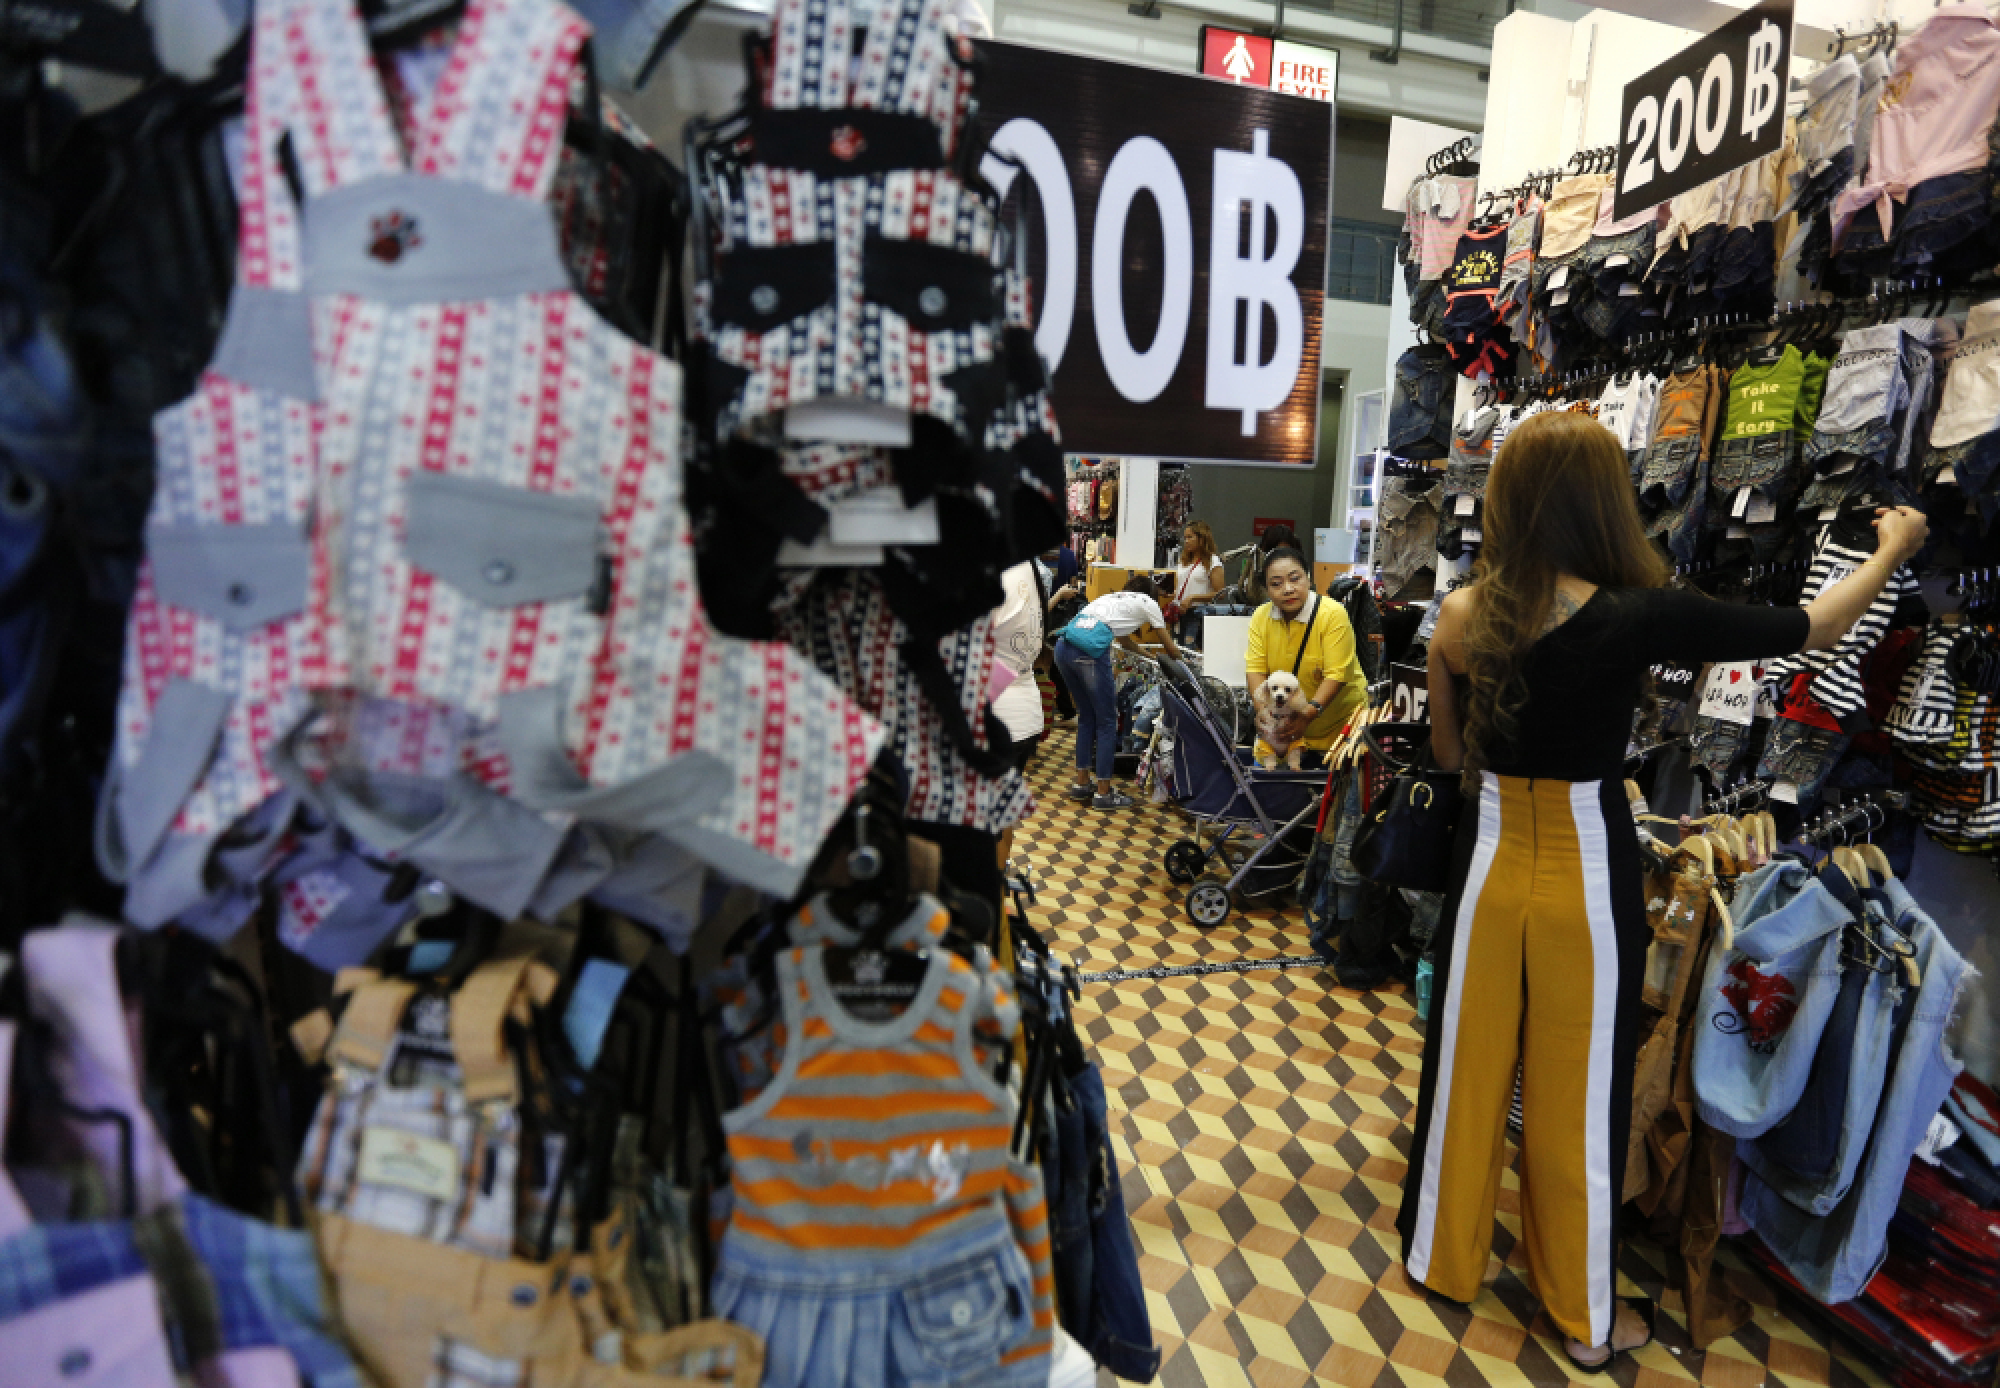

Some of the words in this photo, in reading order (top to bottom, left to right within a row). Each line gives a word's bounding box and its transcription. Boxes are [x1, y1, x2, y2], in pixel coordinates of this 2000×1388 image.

[1279, 61, 1331, 87] FIRE
[1622, 95, 1734, 194] 200
[1741, 382, 1781, 399] Take
